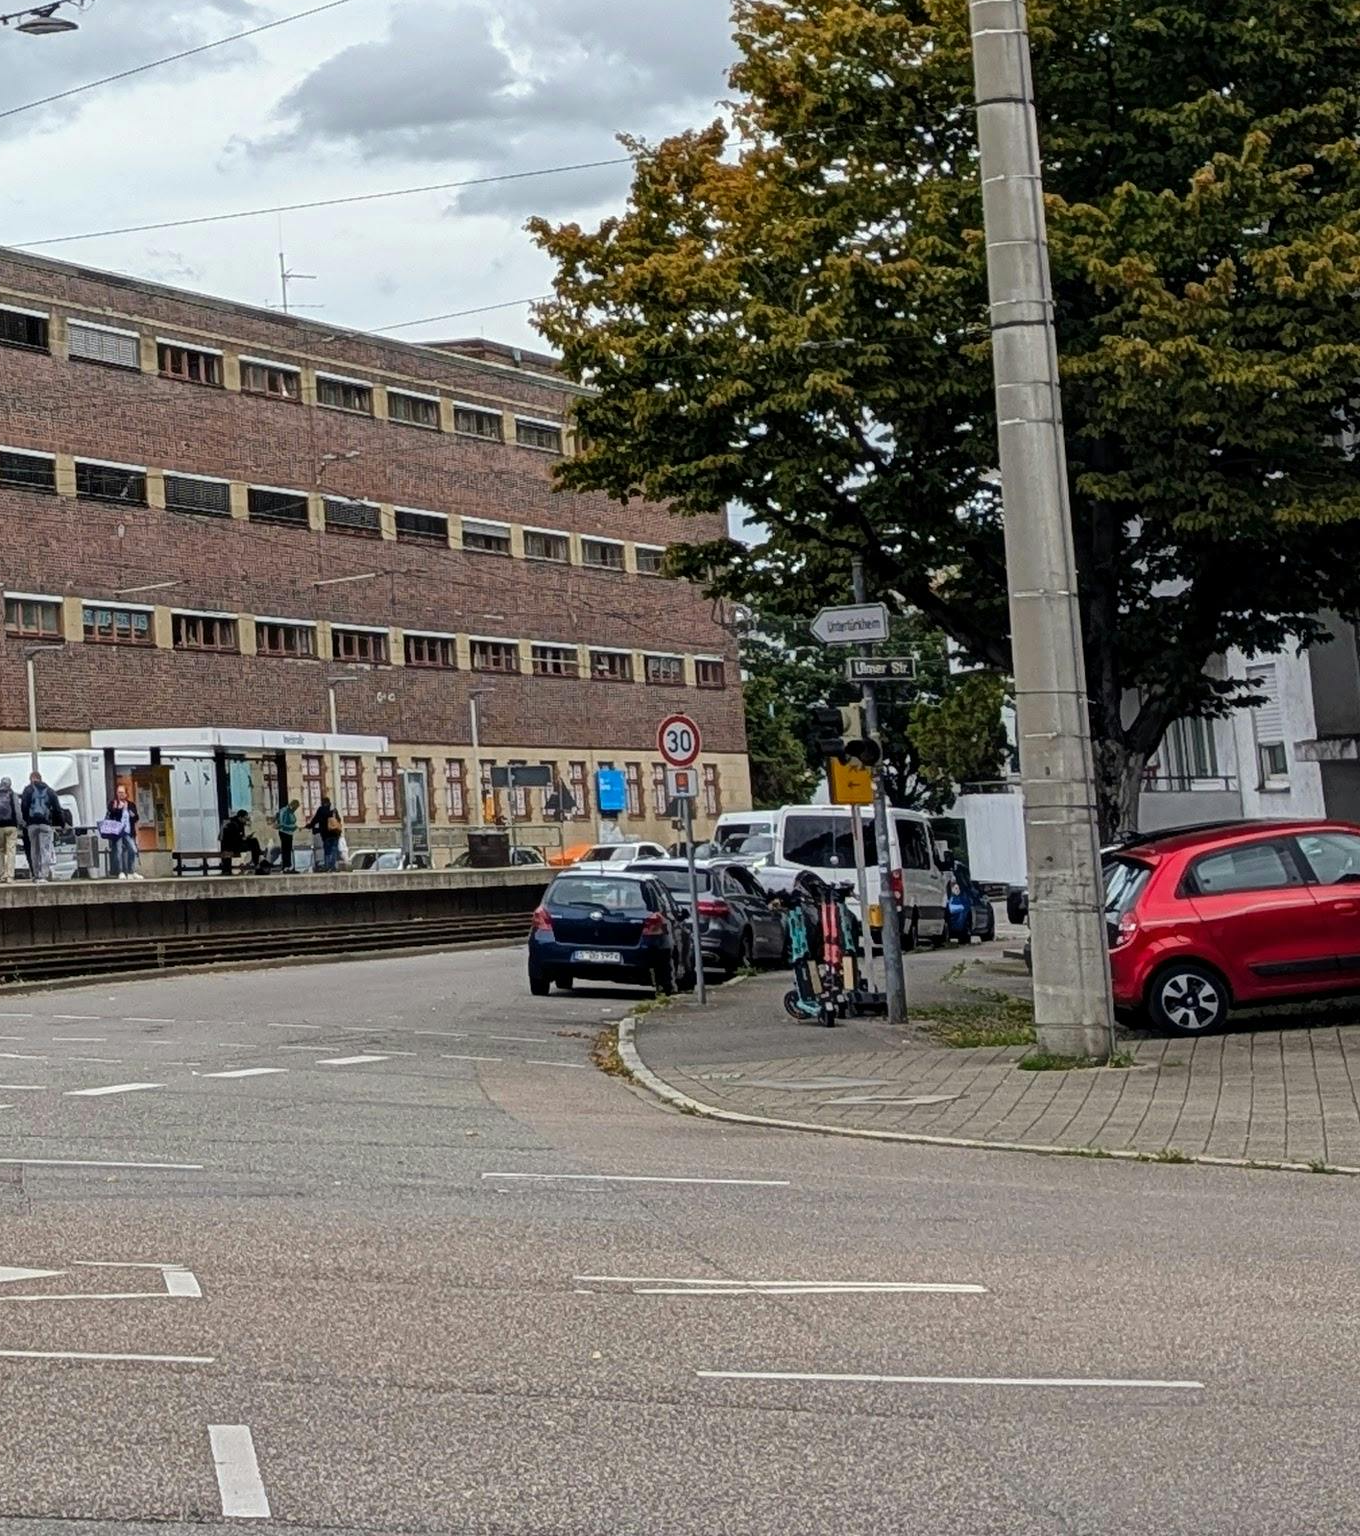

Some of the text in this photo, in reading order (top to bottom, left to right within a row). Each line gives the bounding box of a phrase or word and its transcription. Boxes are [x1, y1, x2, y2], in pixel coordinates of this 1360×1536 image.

[854, 661, 910, 675] Ulmer Str.
[667, 729, 691, 753] 30
